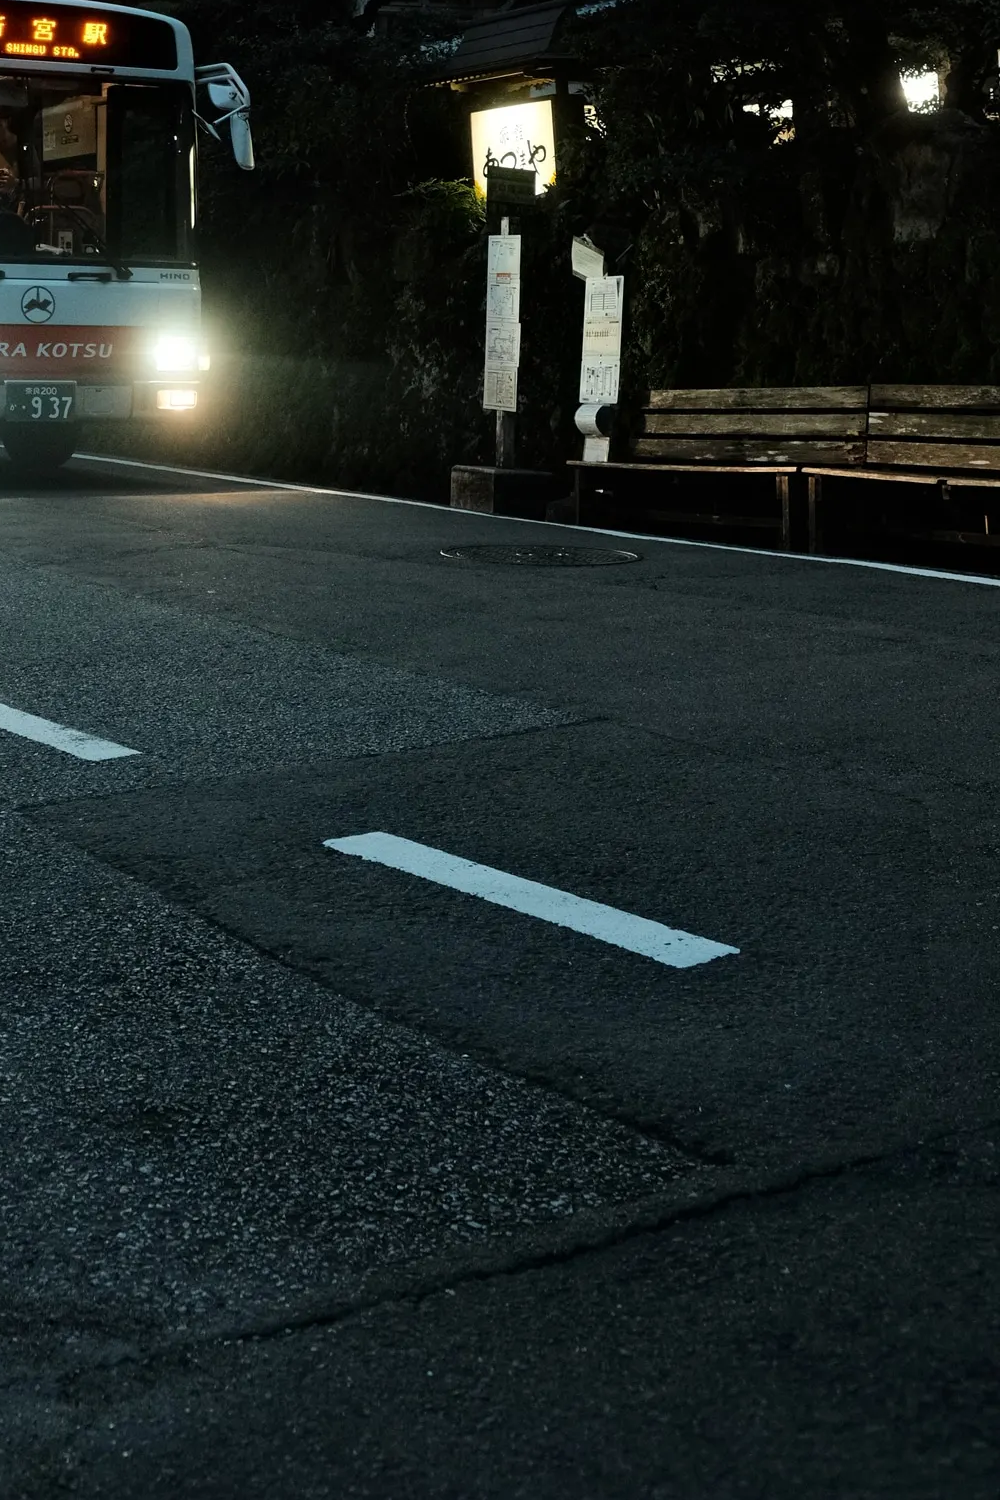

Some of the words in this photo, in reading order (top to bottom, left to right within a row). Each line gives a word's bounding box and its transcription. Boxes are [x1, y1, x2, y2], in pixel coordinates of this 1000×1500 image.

[6, 43, 46, 56] SHINGU
[53, 46, 80, 58] STA.
[159, 272, 190, 281] HINO
[37, 342, 113, 359] KOTSU
